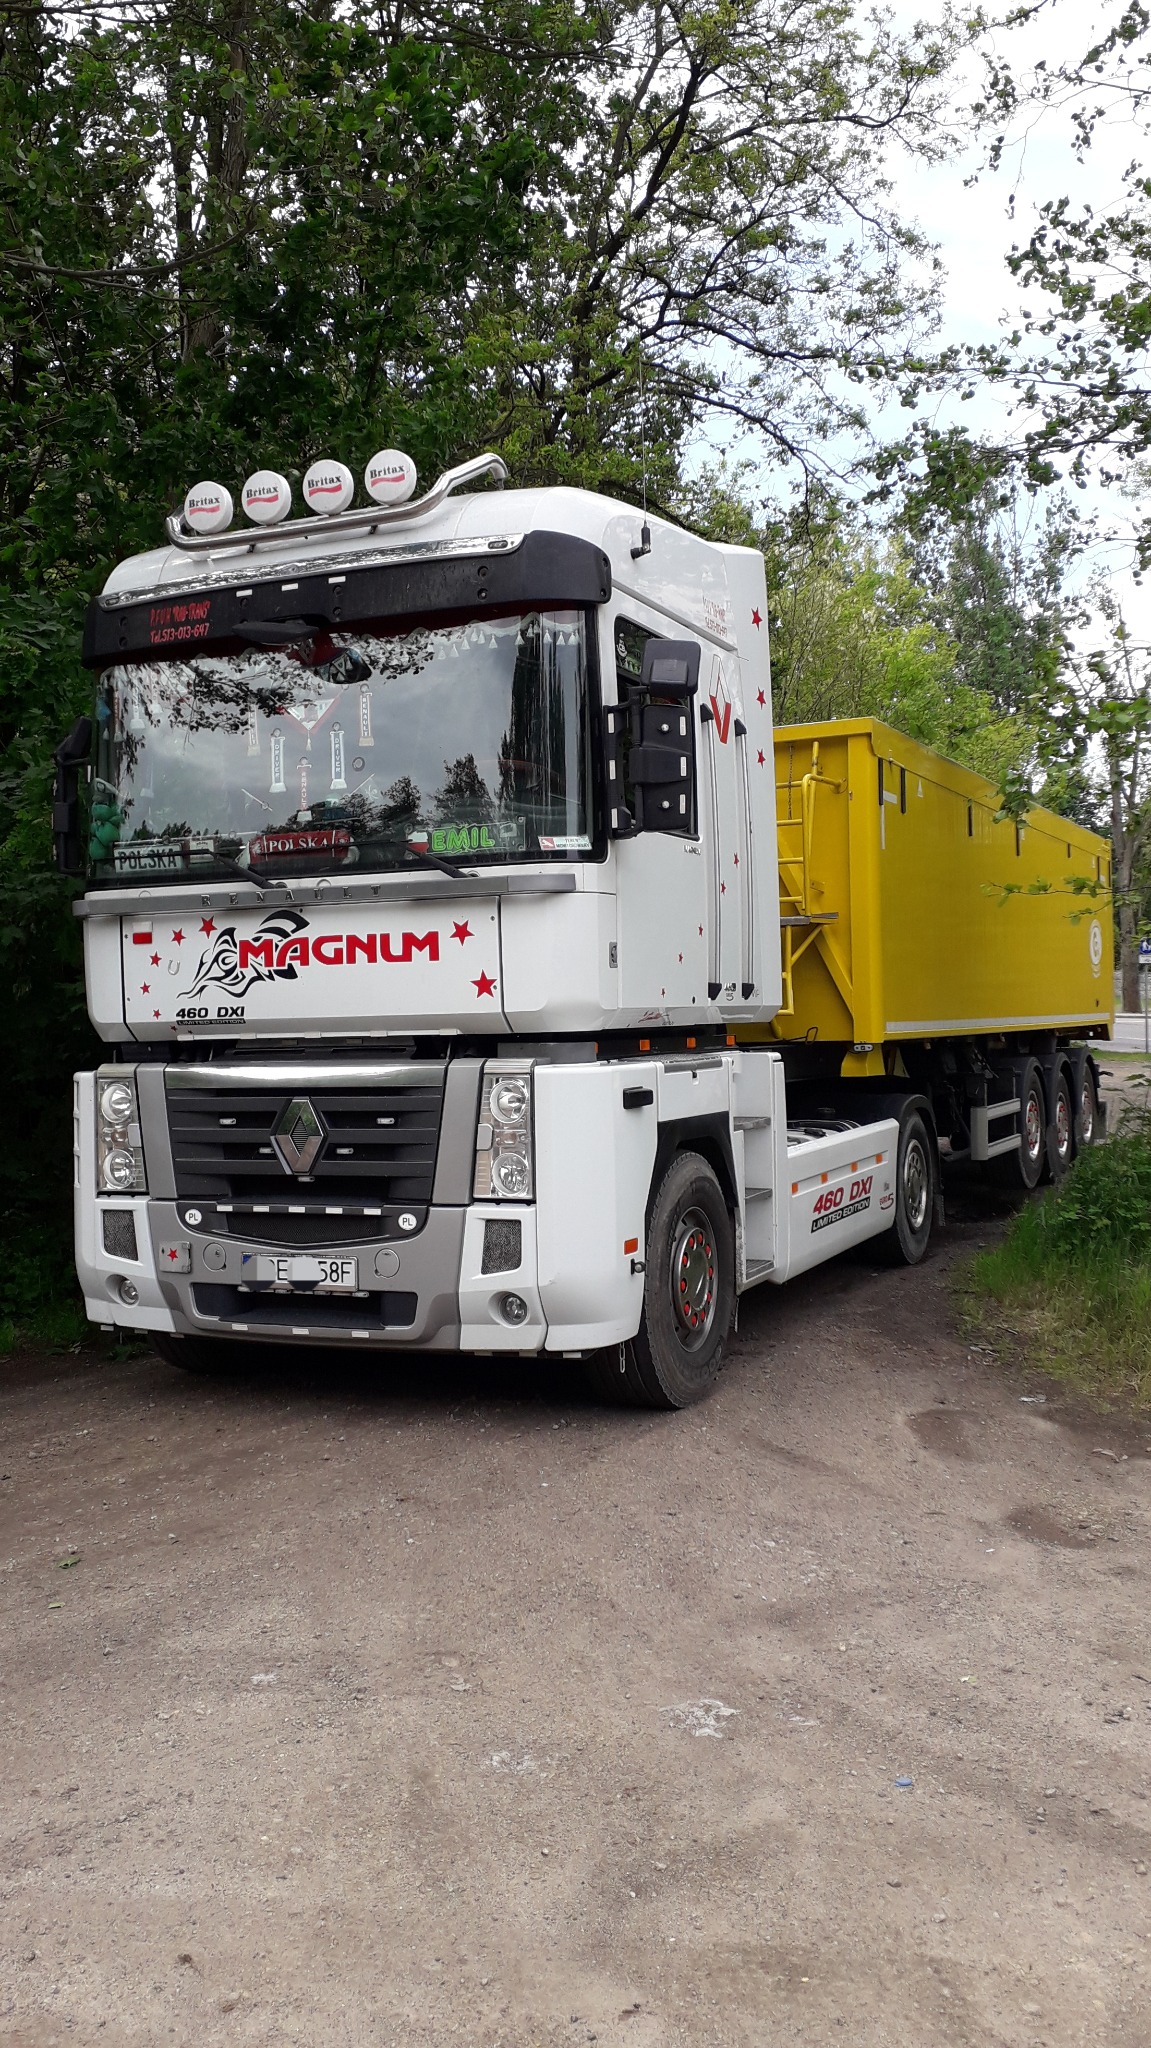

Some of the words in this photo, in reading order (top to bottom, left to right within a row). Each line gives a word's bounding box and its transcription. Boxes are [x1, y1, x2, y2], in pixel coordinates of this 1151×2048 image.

[369, 465, 405, 479] Britax
[307, 475, 342, 489] Britax
[246, 485, 279, 499] Britax
[188, 496, 220, 508] Britax
[269, 838, 328, 852] POLSKA
[432, 826, 495, 851] EMIL
[117, 848, 177, 870] POLSKA
[201, 884, 381, 906] RENAULT
[238, 931, 440, 969] MAGNUM
[176, 1007, 209, 1019] 460
[217, 1006, 245, 1018] DXI
[813, 1187, 844, 1215] 460
[849, 1175, 873, 1202] DXI
[188, 1213, 199, 1222] PL
[402, 1217, 413, 1226] PL
[812, 1210, 843, 1231] LIMITED
[843, 1199, 870, 1216] EDITION
